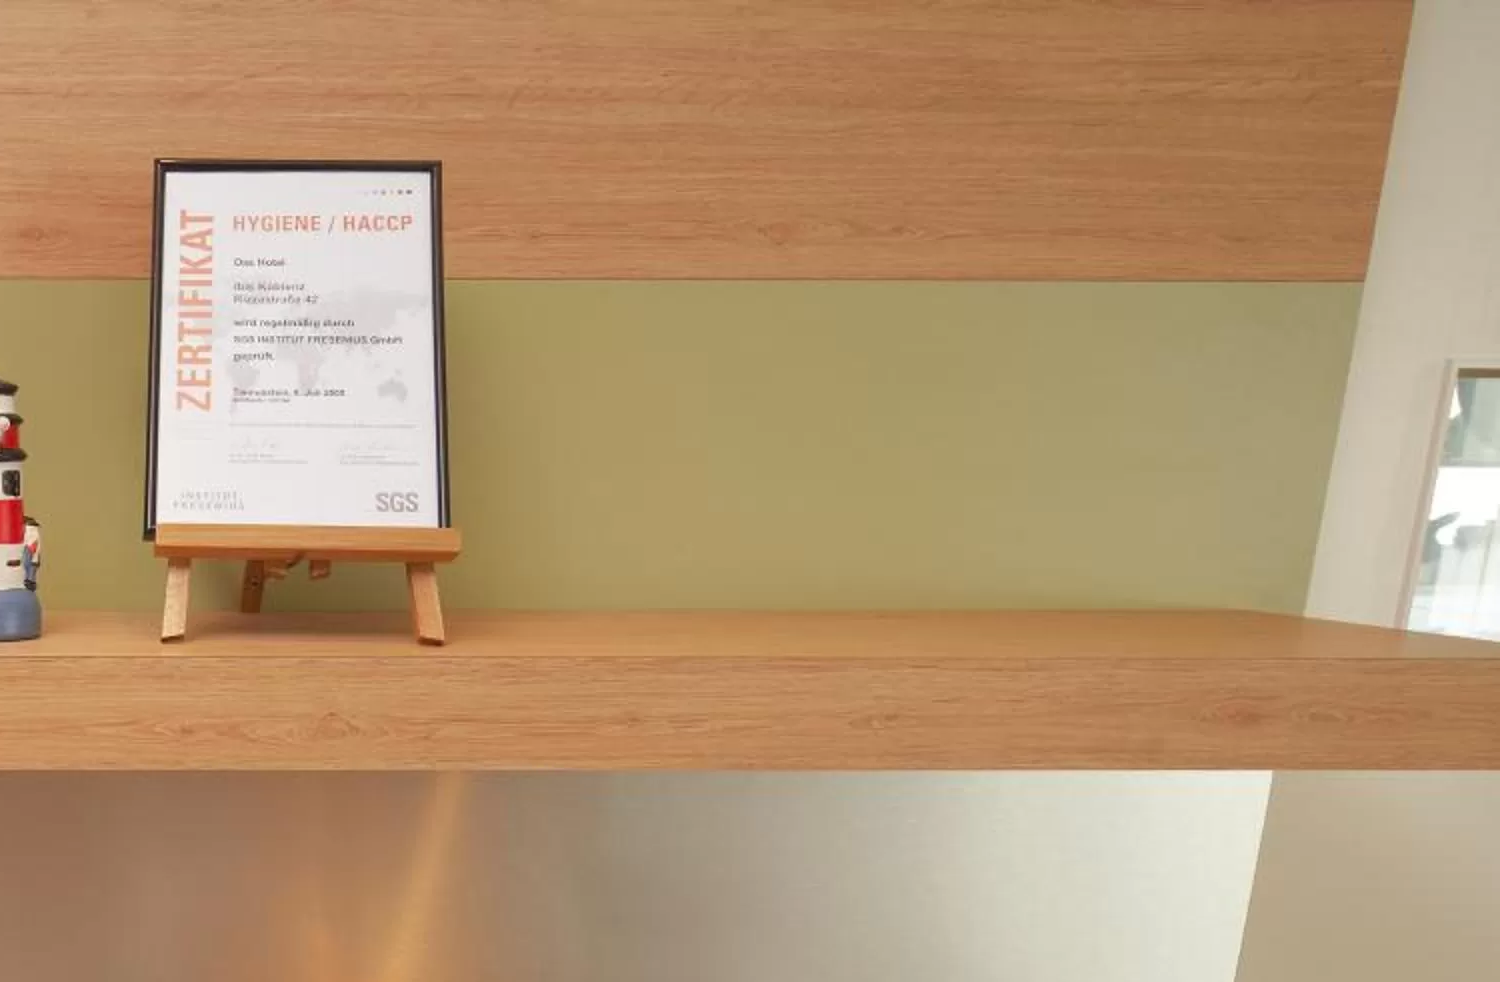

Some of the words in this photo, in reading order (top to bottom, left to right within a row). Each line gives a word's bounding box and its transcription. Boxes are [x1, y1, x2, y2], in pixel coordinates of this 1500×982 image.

[233, 215, 321, 233] HYGIENE
[327, 215, 336, 234] /
[343, 215, 414, 233] HACCP
[176, 209, 214, 412] ZERTIFIKAT
[375, 491, 420, 513] SGS
